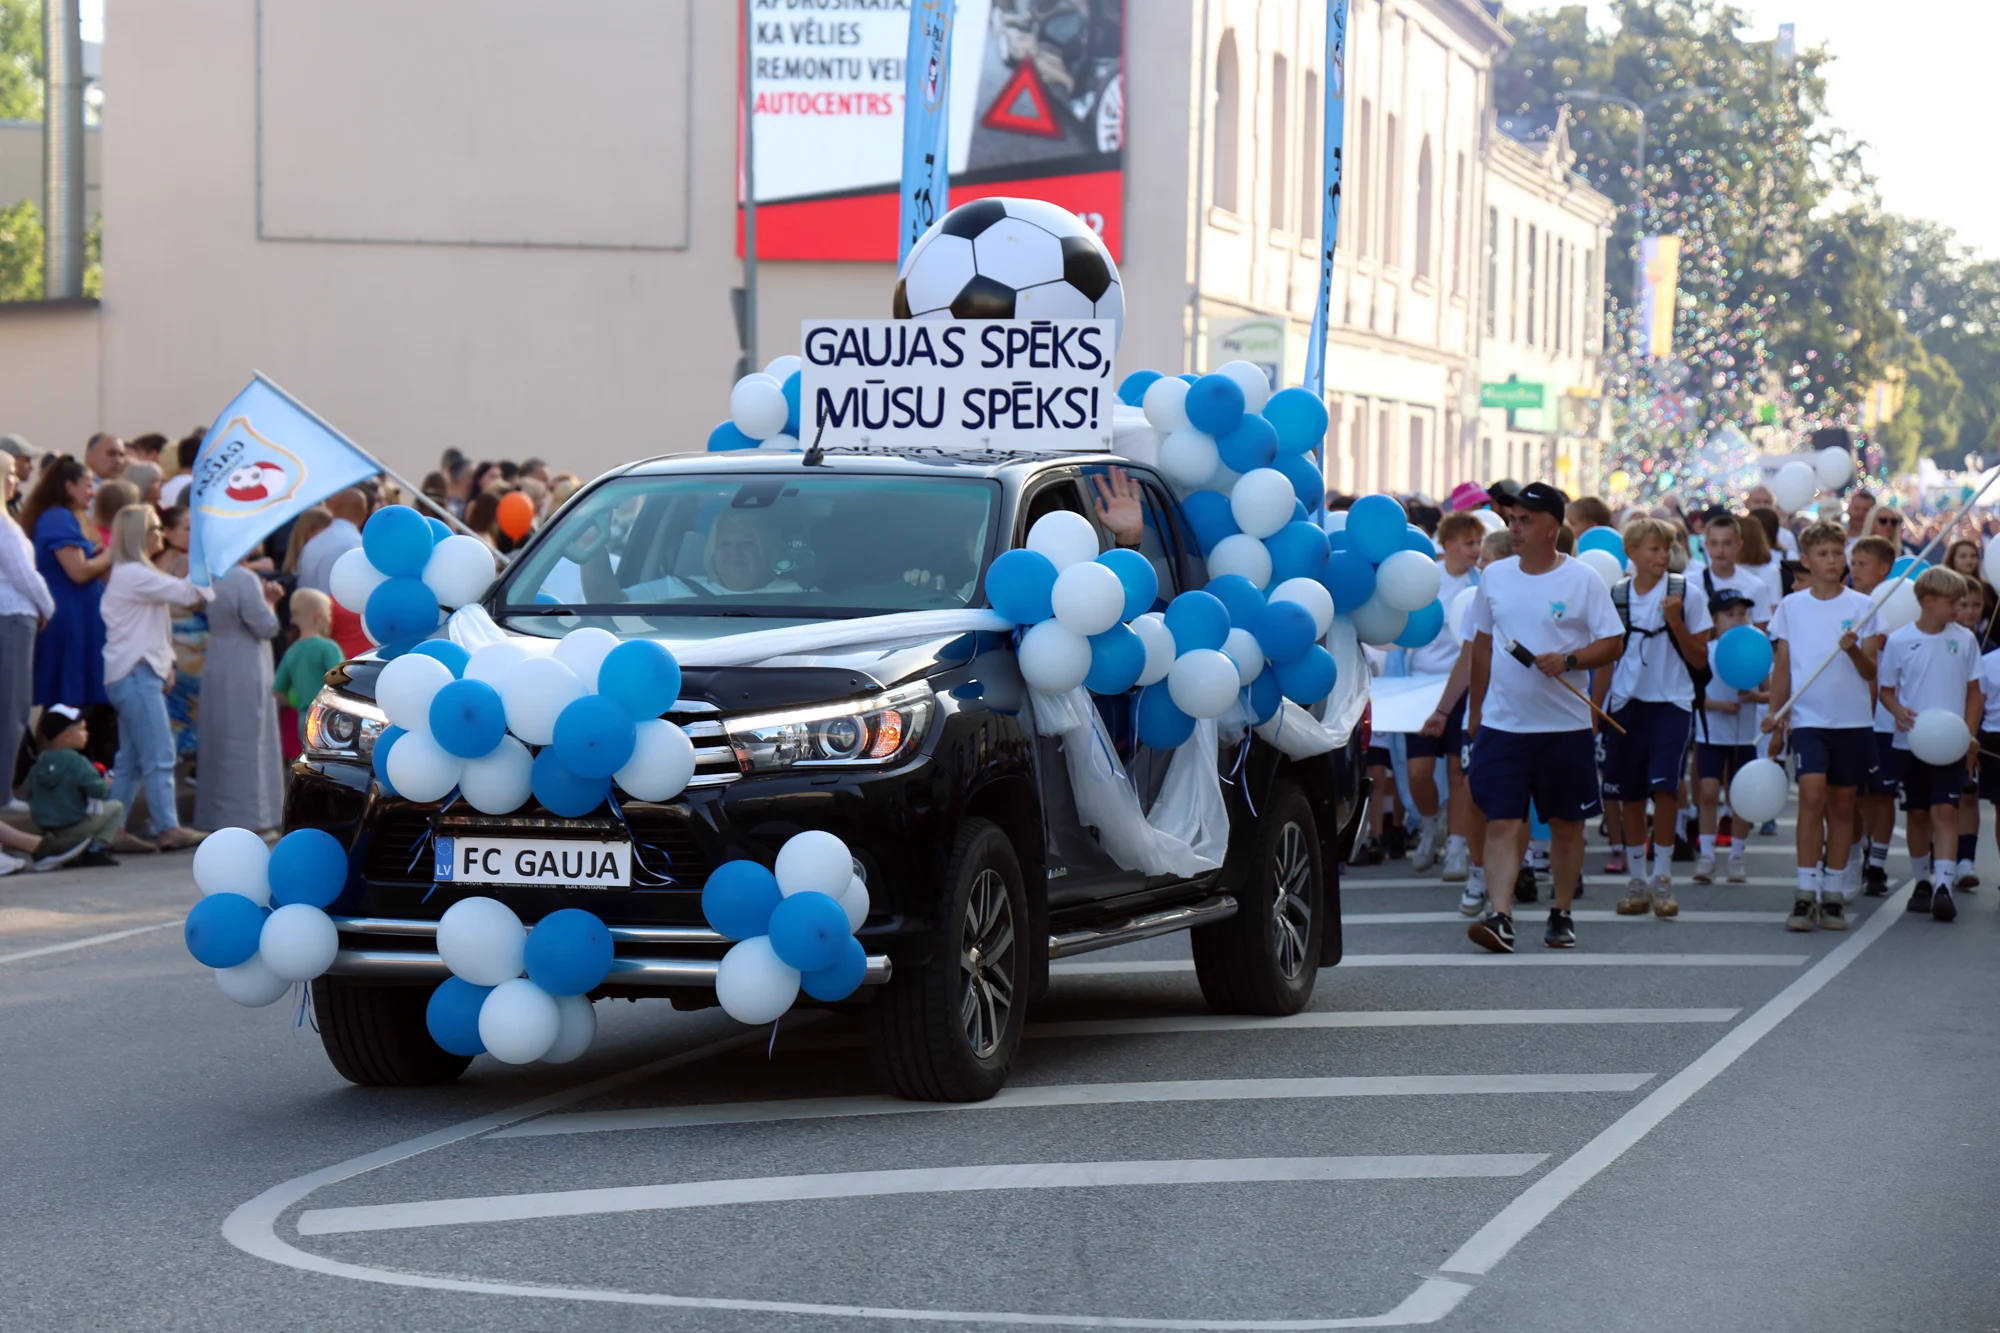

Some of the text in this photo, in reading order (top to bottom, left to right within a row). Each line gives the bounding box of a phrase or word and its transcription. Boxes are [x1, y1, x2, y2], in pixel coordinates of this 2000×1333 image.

[757, 17, 861, 44] KA VĒLIES
[757, 57, 861, 80] REMONTU
[754, 92, 893, 115] AUTOCENTRS
[805, 320, 1111, 378] GAUJAS SPĒKS,
[816, 379, 1099, 429] MŪSU SPĒKS!
[436, 864, 452, 876] LV
[463, 847, 620, 879] FC GAUJA
